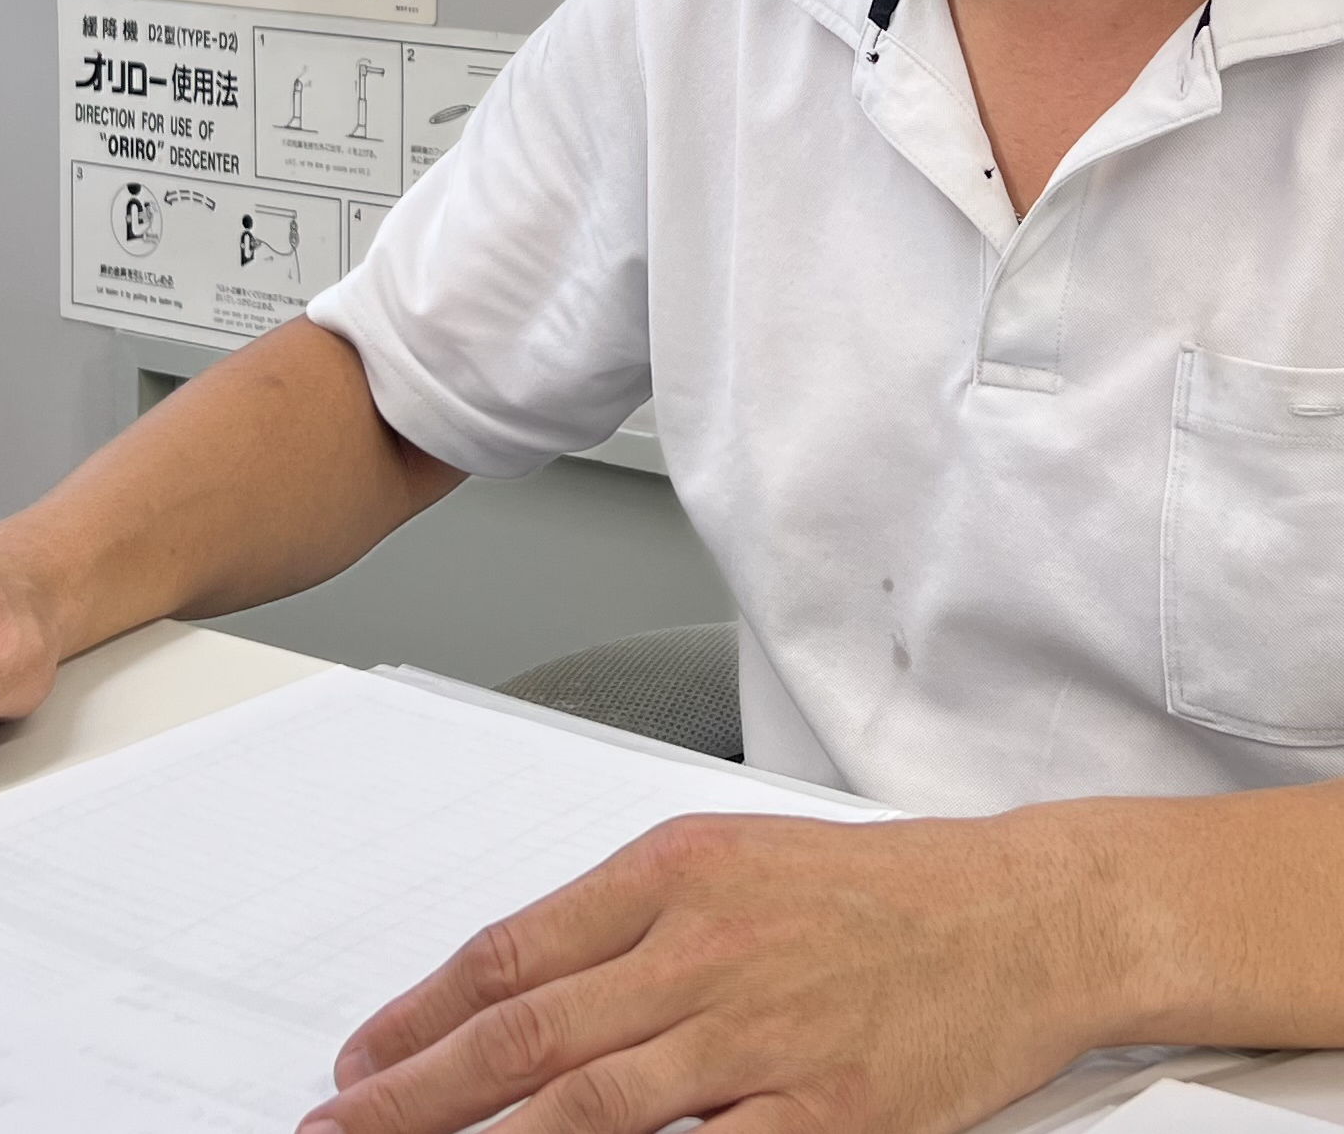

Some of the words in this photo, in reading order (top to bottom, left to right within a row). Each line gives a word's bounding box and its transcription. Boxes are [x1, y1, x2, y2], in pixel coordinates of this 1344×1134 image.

[407, 48, 416, 62] 2
[75, 51, 239, 108] オリロー使用法
[75, 103, 135, 129] DIRECTION
[142, 112, 165, 134] FOR
[170, 115, 192, 138] USE
[199, 120, 215, 141] OF
[169, 145, 241, 175] DESCENTER
[354, 208, 361, 221] 4
